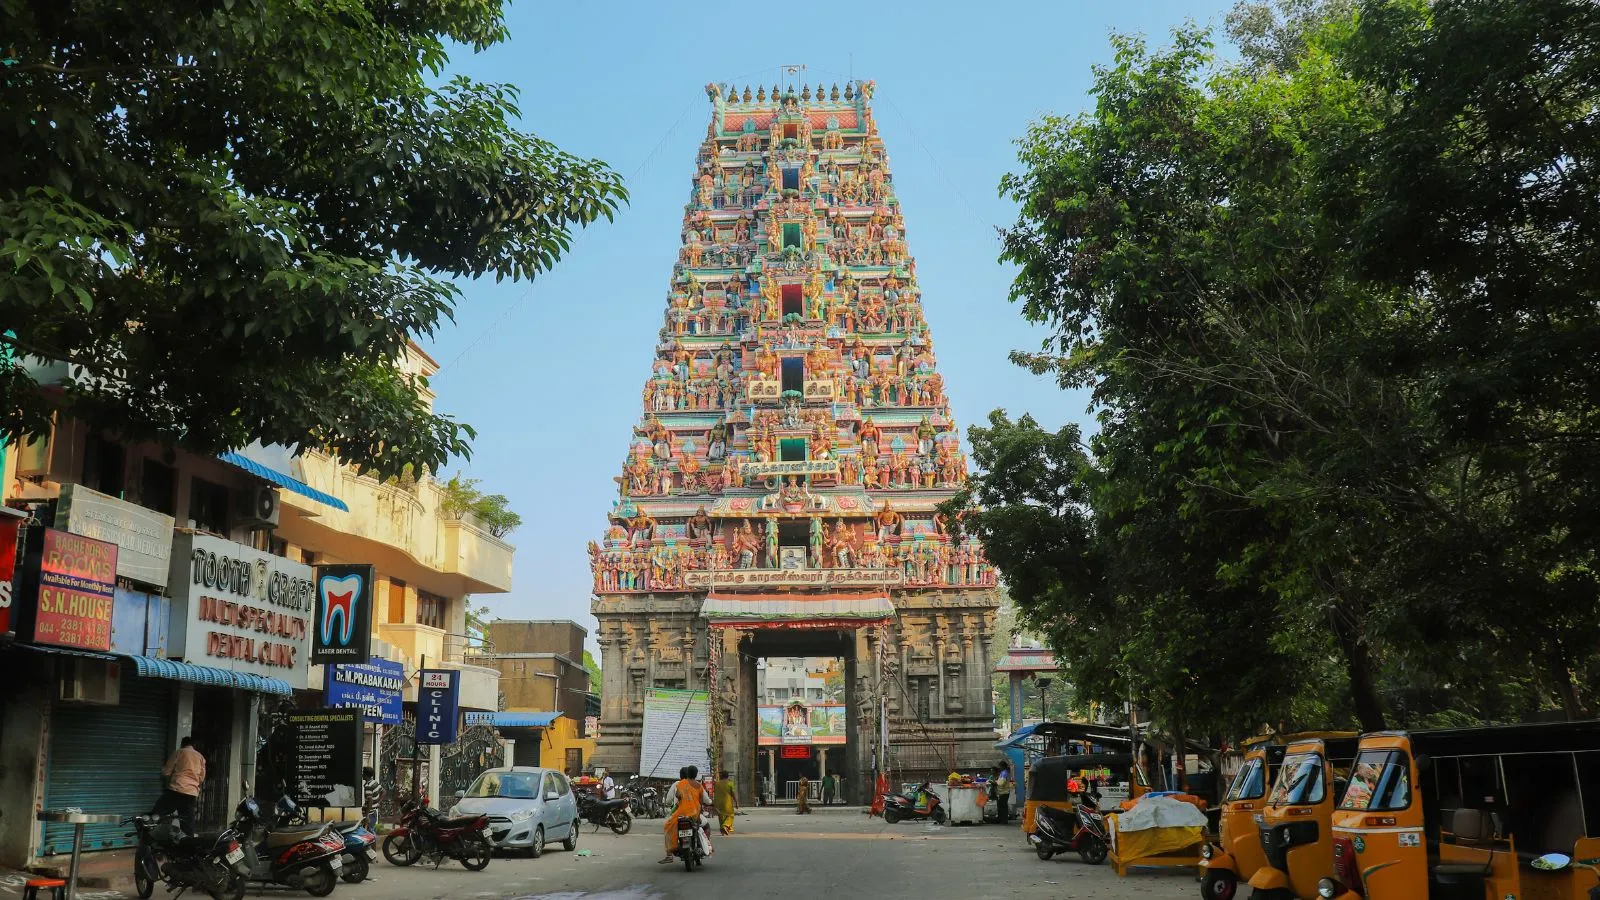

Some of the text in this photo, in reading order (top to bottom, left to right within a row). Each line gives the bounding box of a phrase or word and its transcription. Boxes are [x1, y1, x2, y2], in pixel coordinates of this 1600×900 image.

[751, 381, 778, 396] சிவ
[806, 381, 832, 396] சிவ
[48, 549, 113, 580] ROOMS
[43, 572, 114, 594] Available For Monthly Rent
[191, 547, 314, 612] TOOTH CRAFT
[41, 589, 111, 622] S.N.HOUSE
[61, 618, 83, 632] 2381
[59, 631, 82, 644] 2381
[206, 631, 298, 668] DENTAL CLINIC
[336, 670, 345, 682] Dr.
[428, 690, 443, 738] CLINIC
